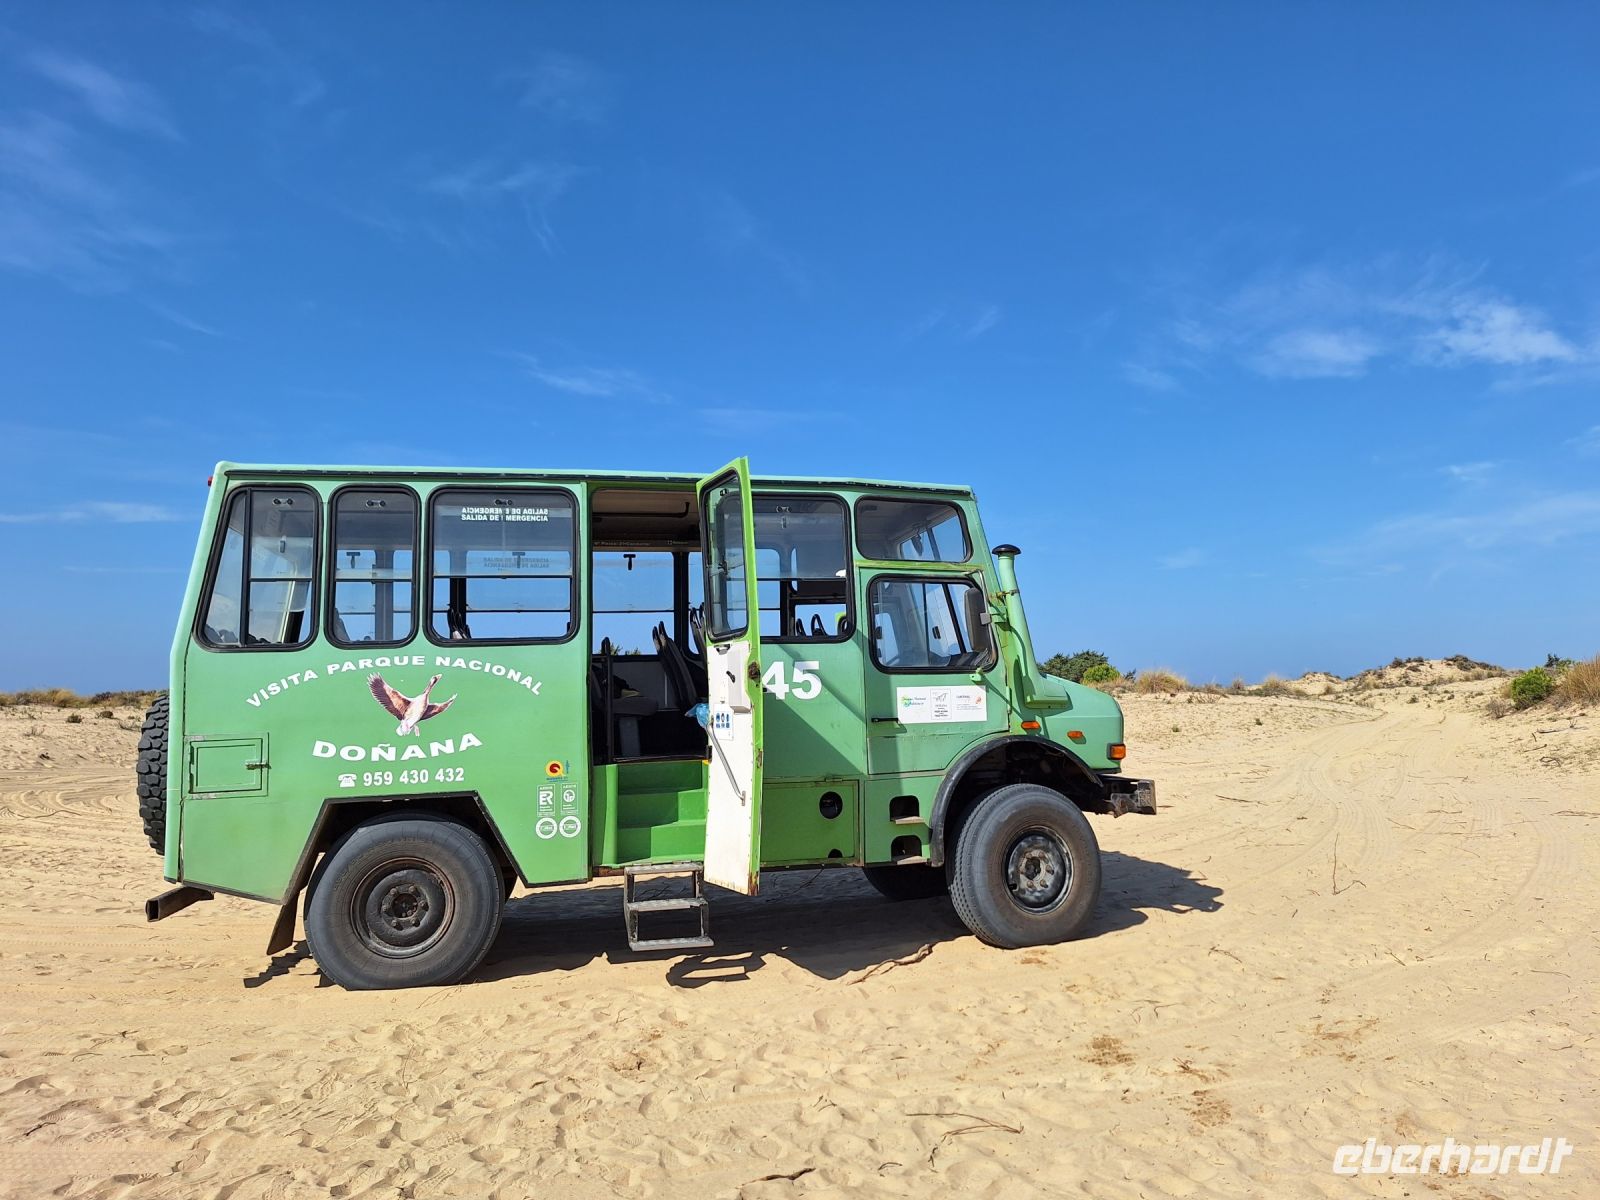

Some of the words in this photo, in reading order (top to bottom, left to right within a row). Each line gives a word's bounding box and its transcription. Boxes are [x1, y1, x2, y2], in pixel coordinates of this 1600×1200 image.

[246, 669, 319, 708] VISITA
[326, 655, 426, 675] PARQUE
[435, 655, 543, 696] NACIONAL
[761, 660, 823, 700] 45
[311, 732, 483, 762] DOÑANA
[362, 771, 394, 787] 959
[399, 768, 429, 785] 430
[434, 767, 465, 783] 432
